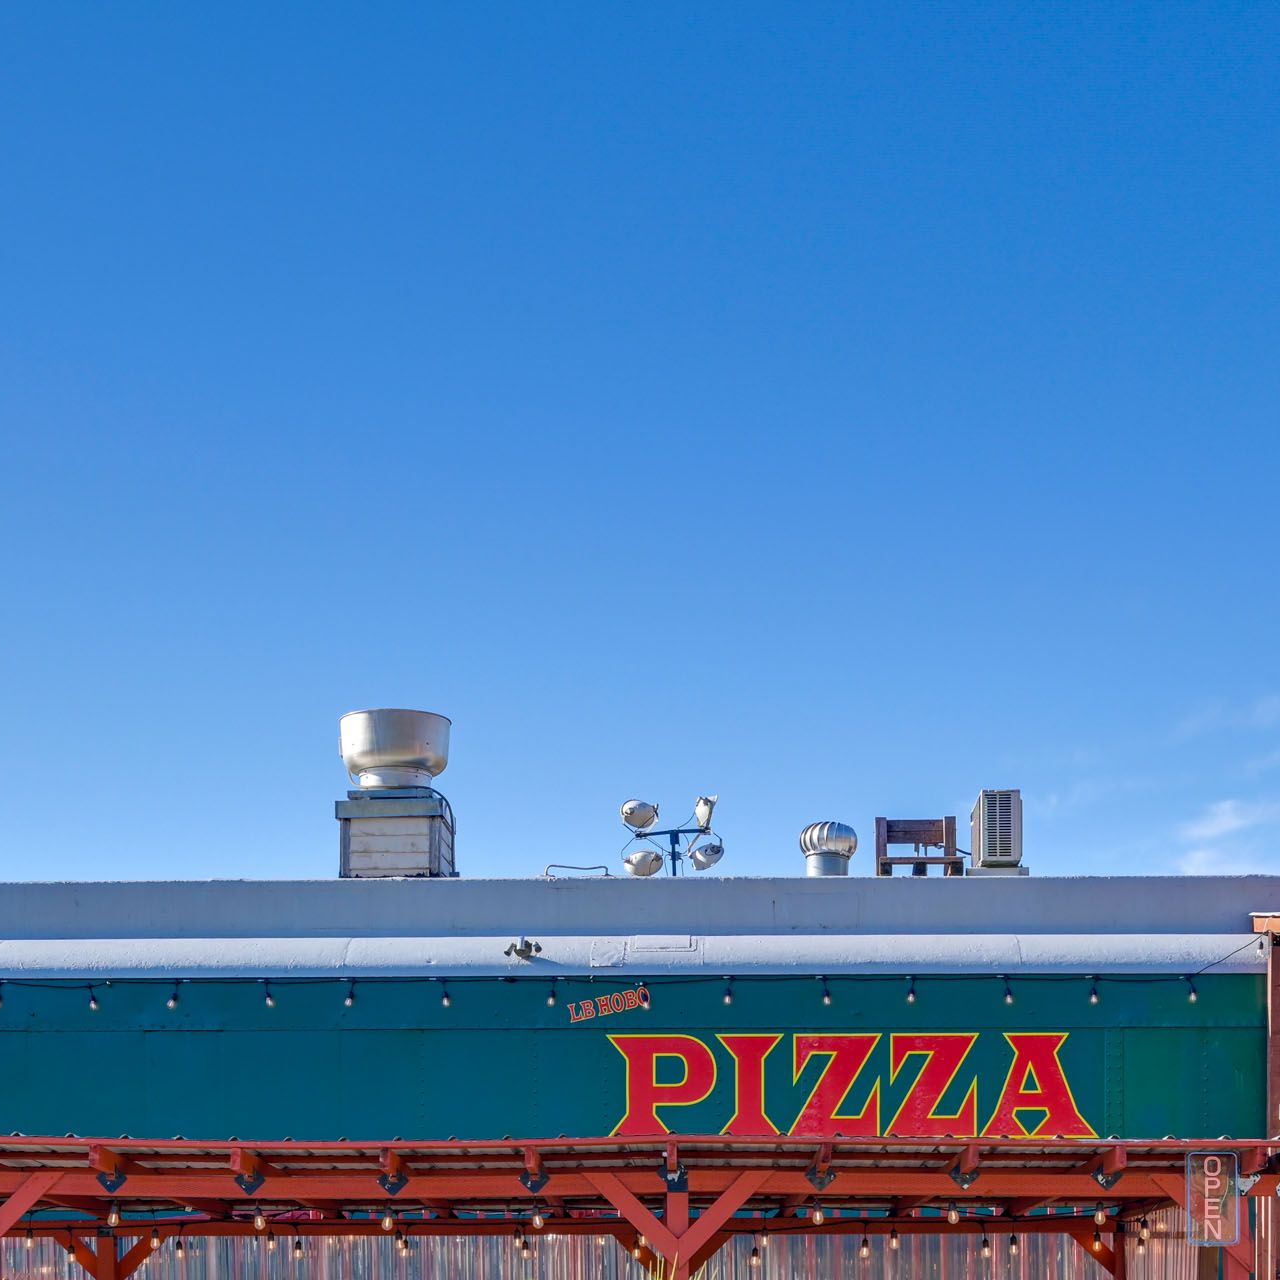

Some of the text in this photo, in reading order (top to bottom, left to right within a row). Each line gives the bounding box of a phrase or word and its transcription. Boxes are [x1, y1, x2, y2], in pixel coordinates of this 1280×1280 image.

[595, 987, 650, 1016] HOBO
[606, 1032, 1099, 1138] PIZZA
[1203, 1156, 1222, 1241] OPEN
